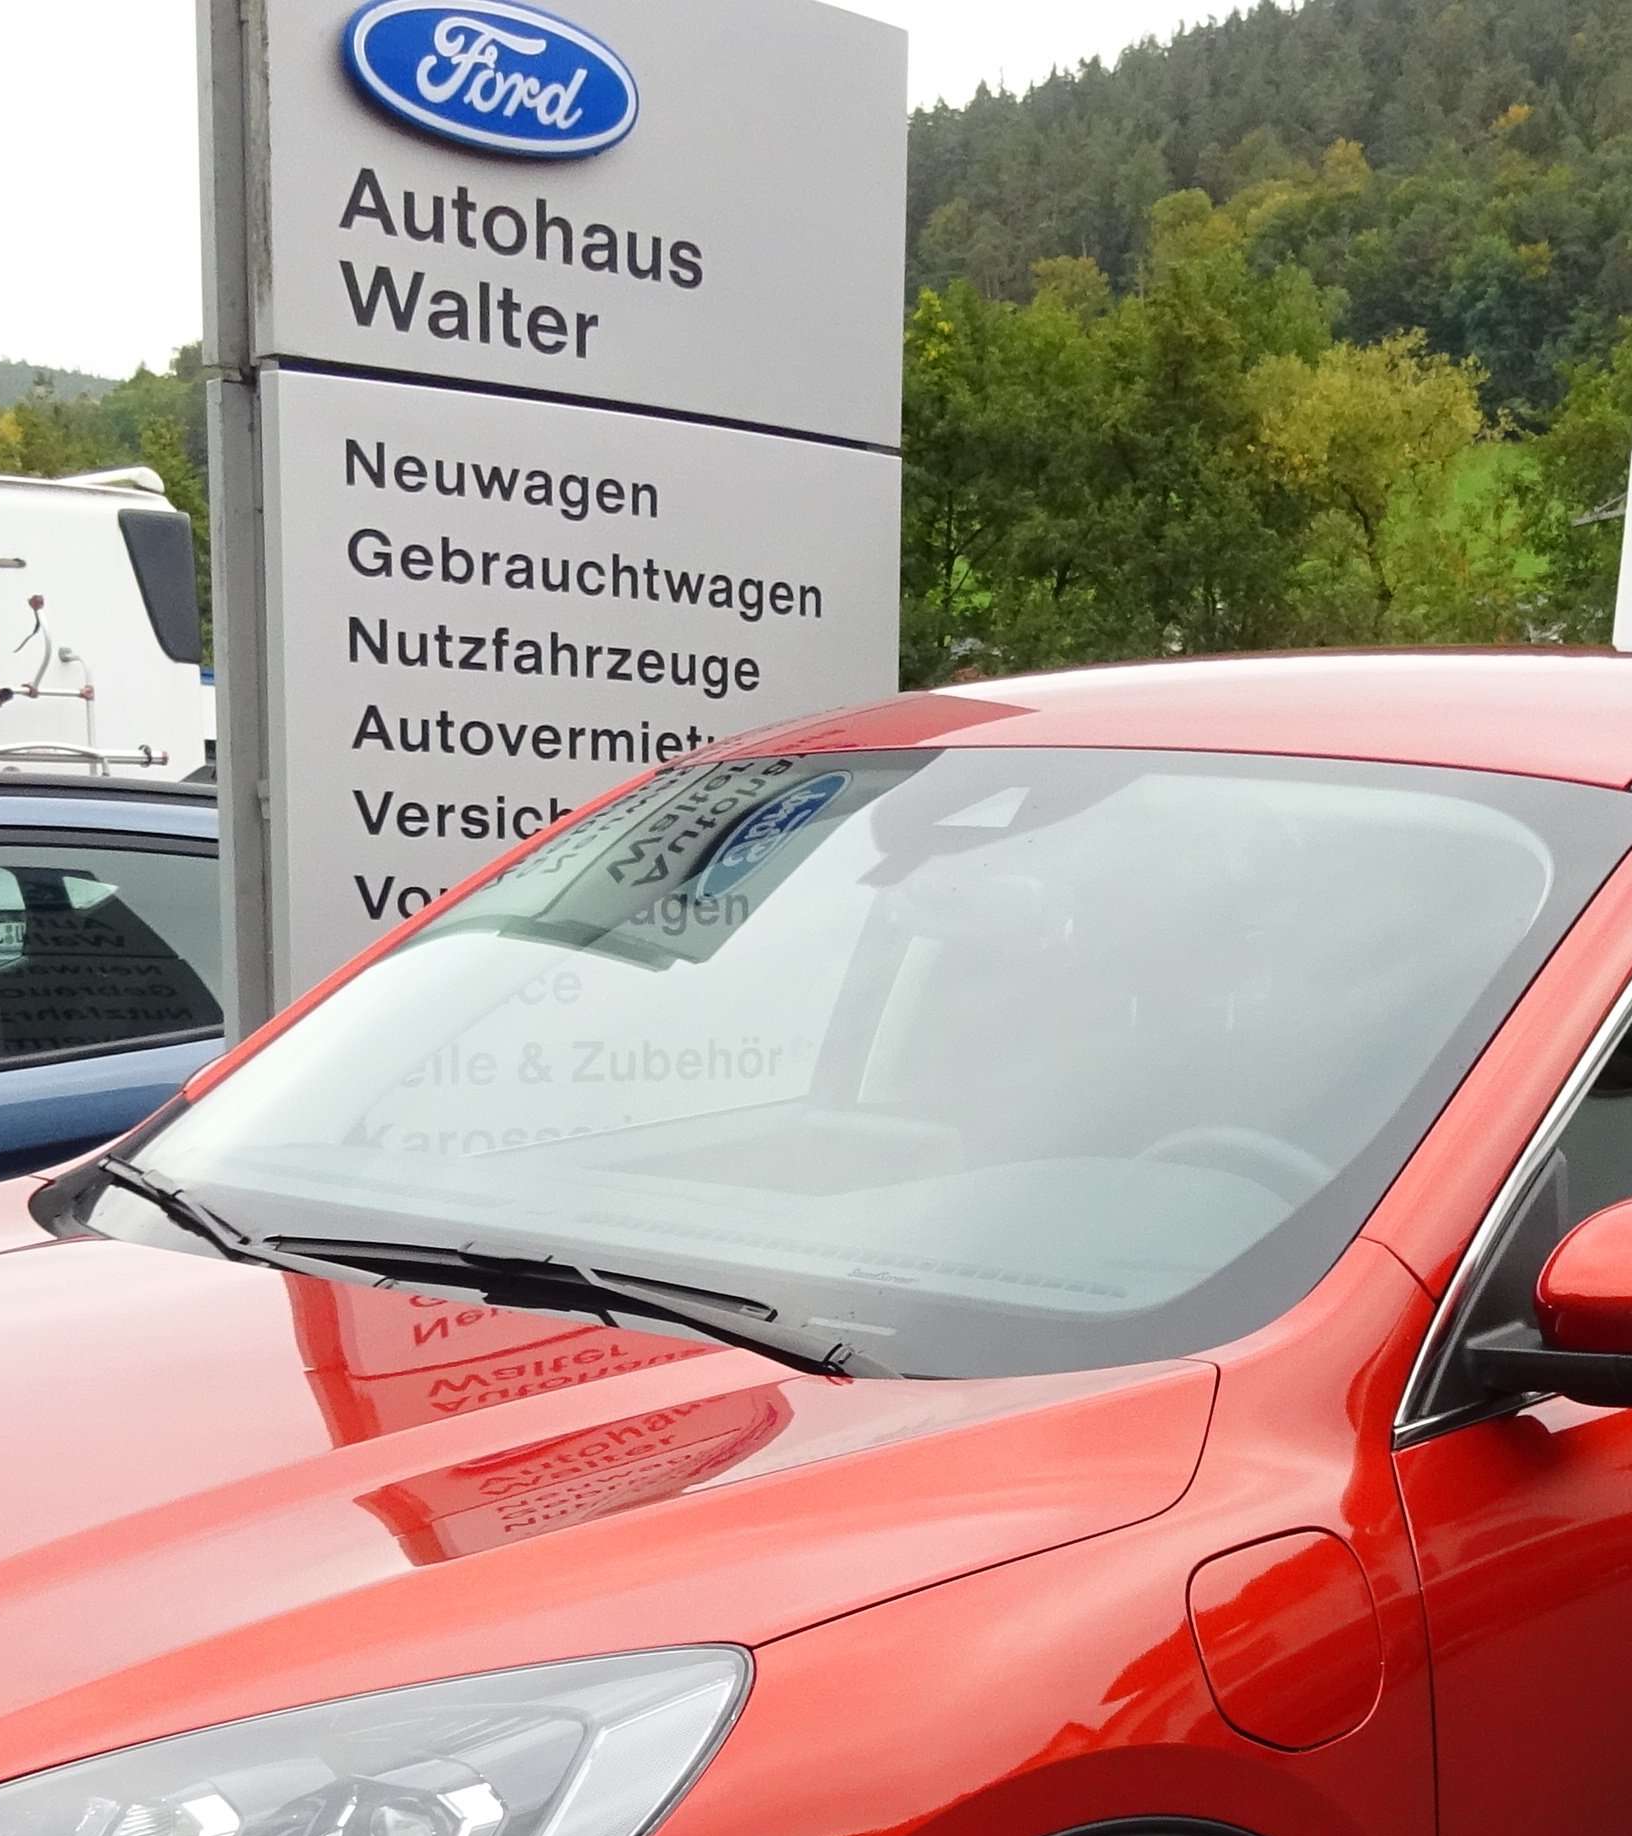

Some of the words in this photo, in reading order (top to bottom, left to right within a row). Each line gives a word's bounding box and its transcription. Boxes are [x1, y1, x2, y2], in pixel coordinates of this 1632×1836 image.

[415, 15, 588, 129] Ford
[338, 167, 705, 290] Autohaus
[338, 260, 600, 359] Walter
[344, 437, 660, 521] Neuwagen
[346, 527, 824, 622] Gebrauchtwagen
[347, 616, 761, 700] Nutzfahrzeuge
[351, 703, 714, 765] Autovermiet
[354, 874, 448, 921] Vo
[401, 1042, 498, 1088] eile
[517, 1041, 554, 1085] &
[570, 1034, 784, 1084] Zubehör
